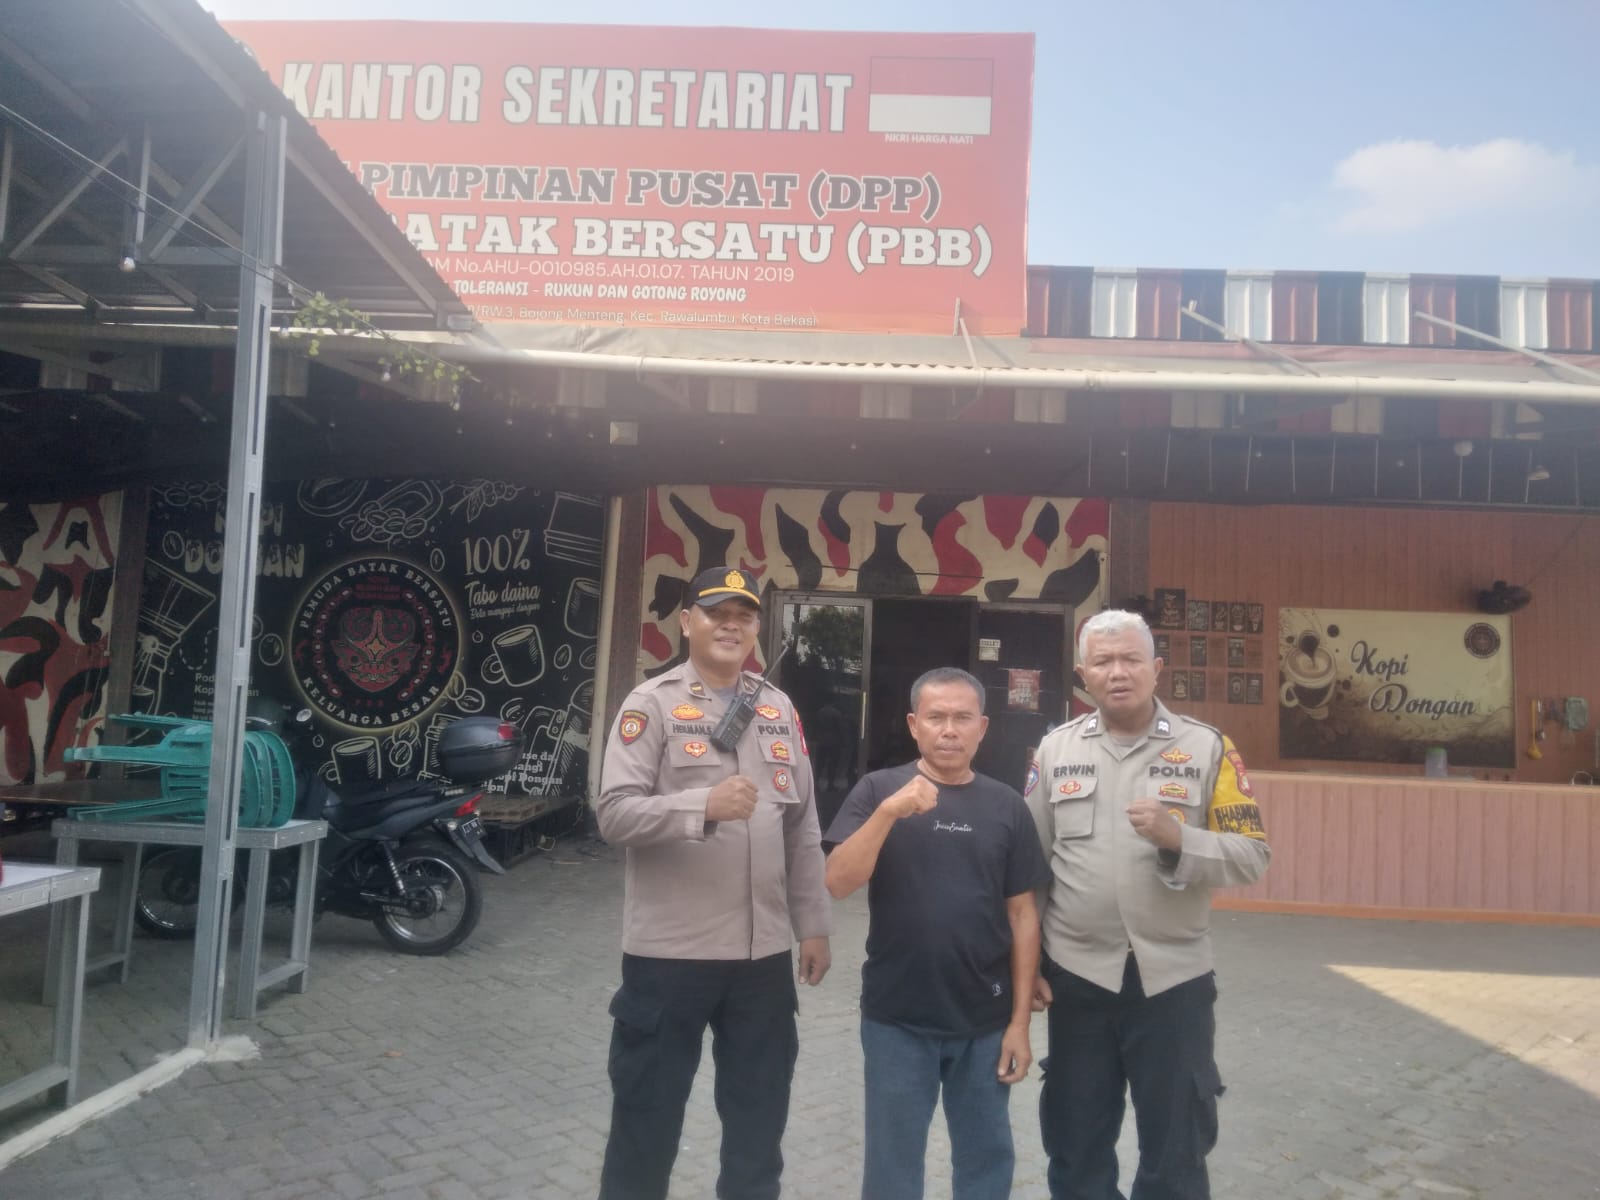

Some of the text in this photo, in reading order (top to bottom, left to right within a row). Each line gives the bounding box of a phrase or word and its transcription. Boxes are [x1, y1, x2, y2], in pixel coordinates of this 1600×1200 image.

[282, 62, 855, 133] KANTOR SEKRETARIAT
[884, 132, 974, 146] NKRI HARGA MATI
[360, 161, 942, 222] PIMPINAN PUSAT (DPP)
[391, 212, 993, 278] ATAK BERSATU (PBB)
[454, 279, 529, 297] TOLERANSI
[543, 282, 593, 298] RUKUN
[597, 283, 628, 299] DAN
[632, 284, 687, 301] GOTONG
[691, 286, 747, 302] ROYONG
[690, 264, 749, 281] TAHUN
[754, 266, 795, 283] 2019
[519, 307, 564, 322] Bojong
[741, 313, 770, 325] Kota
[774, 314, 817, 327] Bekasi
[462, 528, 530, 575] 100%
[299, 562, 452, 629] PEMUDA BATAK BERSATU
[1350, 639, 1409, 682] Kopi
[303, 676, 439, 725] KELUARGA BESAR
[1370, 682, 1477, 721] Dongan
[758, 724, 790, 736] POLRI
[1053, 764, 1095, 779] ERWIN
[1149, 765, 1202, 779] POLRI
